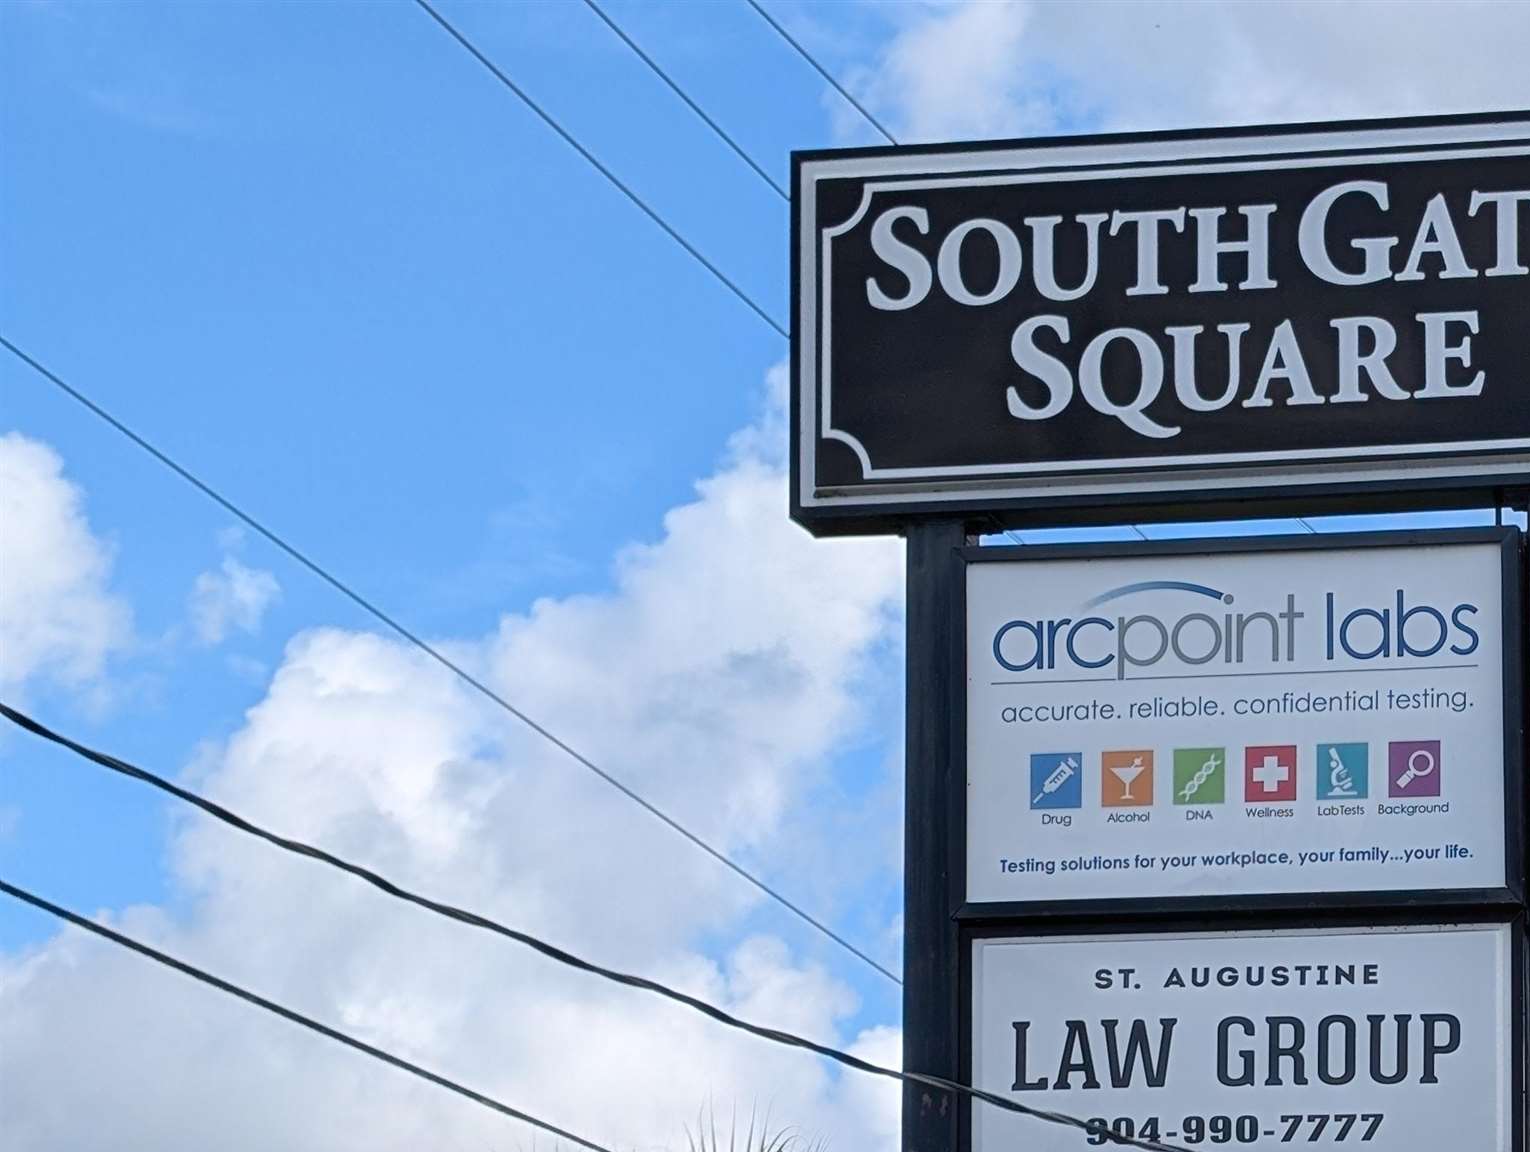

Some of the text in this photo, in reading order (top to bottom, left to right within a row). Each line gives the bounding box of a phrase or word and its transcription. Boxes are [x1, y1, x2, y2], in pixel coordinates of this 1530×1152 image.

[866, 204, 1277, 311] SOUTH
[1007, 311, 1485, 439] SQUARE
[992, 589, 1480, 680] arcpoint labs
[1001, 688, 1475, 723] accurate. reliable. confidential testing.
[1041, 813, 1072, 826] Drug
[1107, 811, 1150, 823] Alcohol
[1185, 810, 1213, 821] DNA
[1245, 806, 1294, 818] Wellness
[1377, 802, 1449, 816] Background
[1001, 858, 1056, 875] Testing
[1060, 856, 1130, 872] solutions
[1135, 854, 1156, 869] for
[1160, 855, 1197, 871] your
[1201, 850, 1294, 869] workplace,
[1299, 850, 1334, 866] your
[1445, 844, 1473, 859] life.
[1094, 964, 1379, 990] ST. AUGUSTINE
[1011, 1013, 1461, 1091] LAW GROUP
[1085, 1113, 1385, 1146] 904-990-7777
